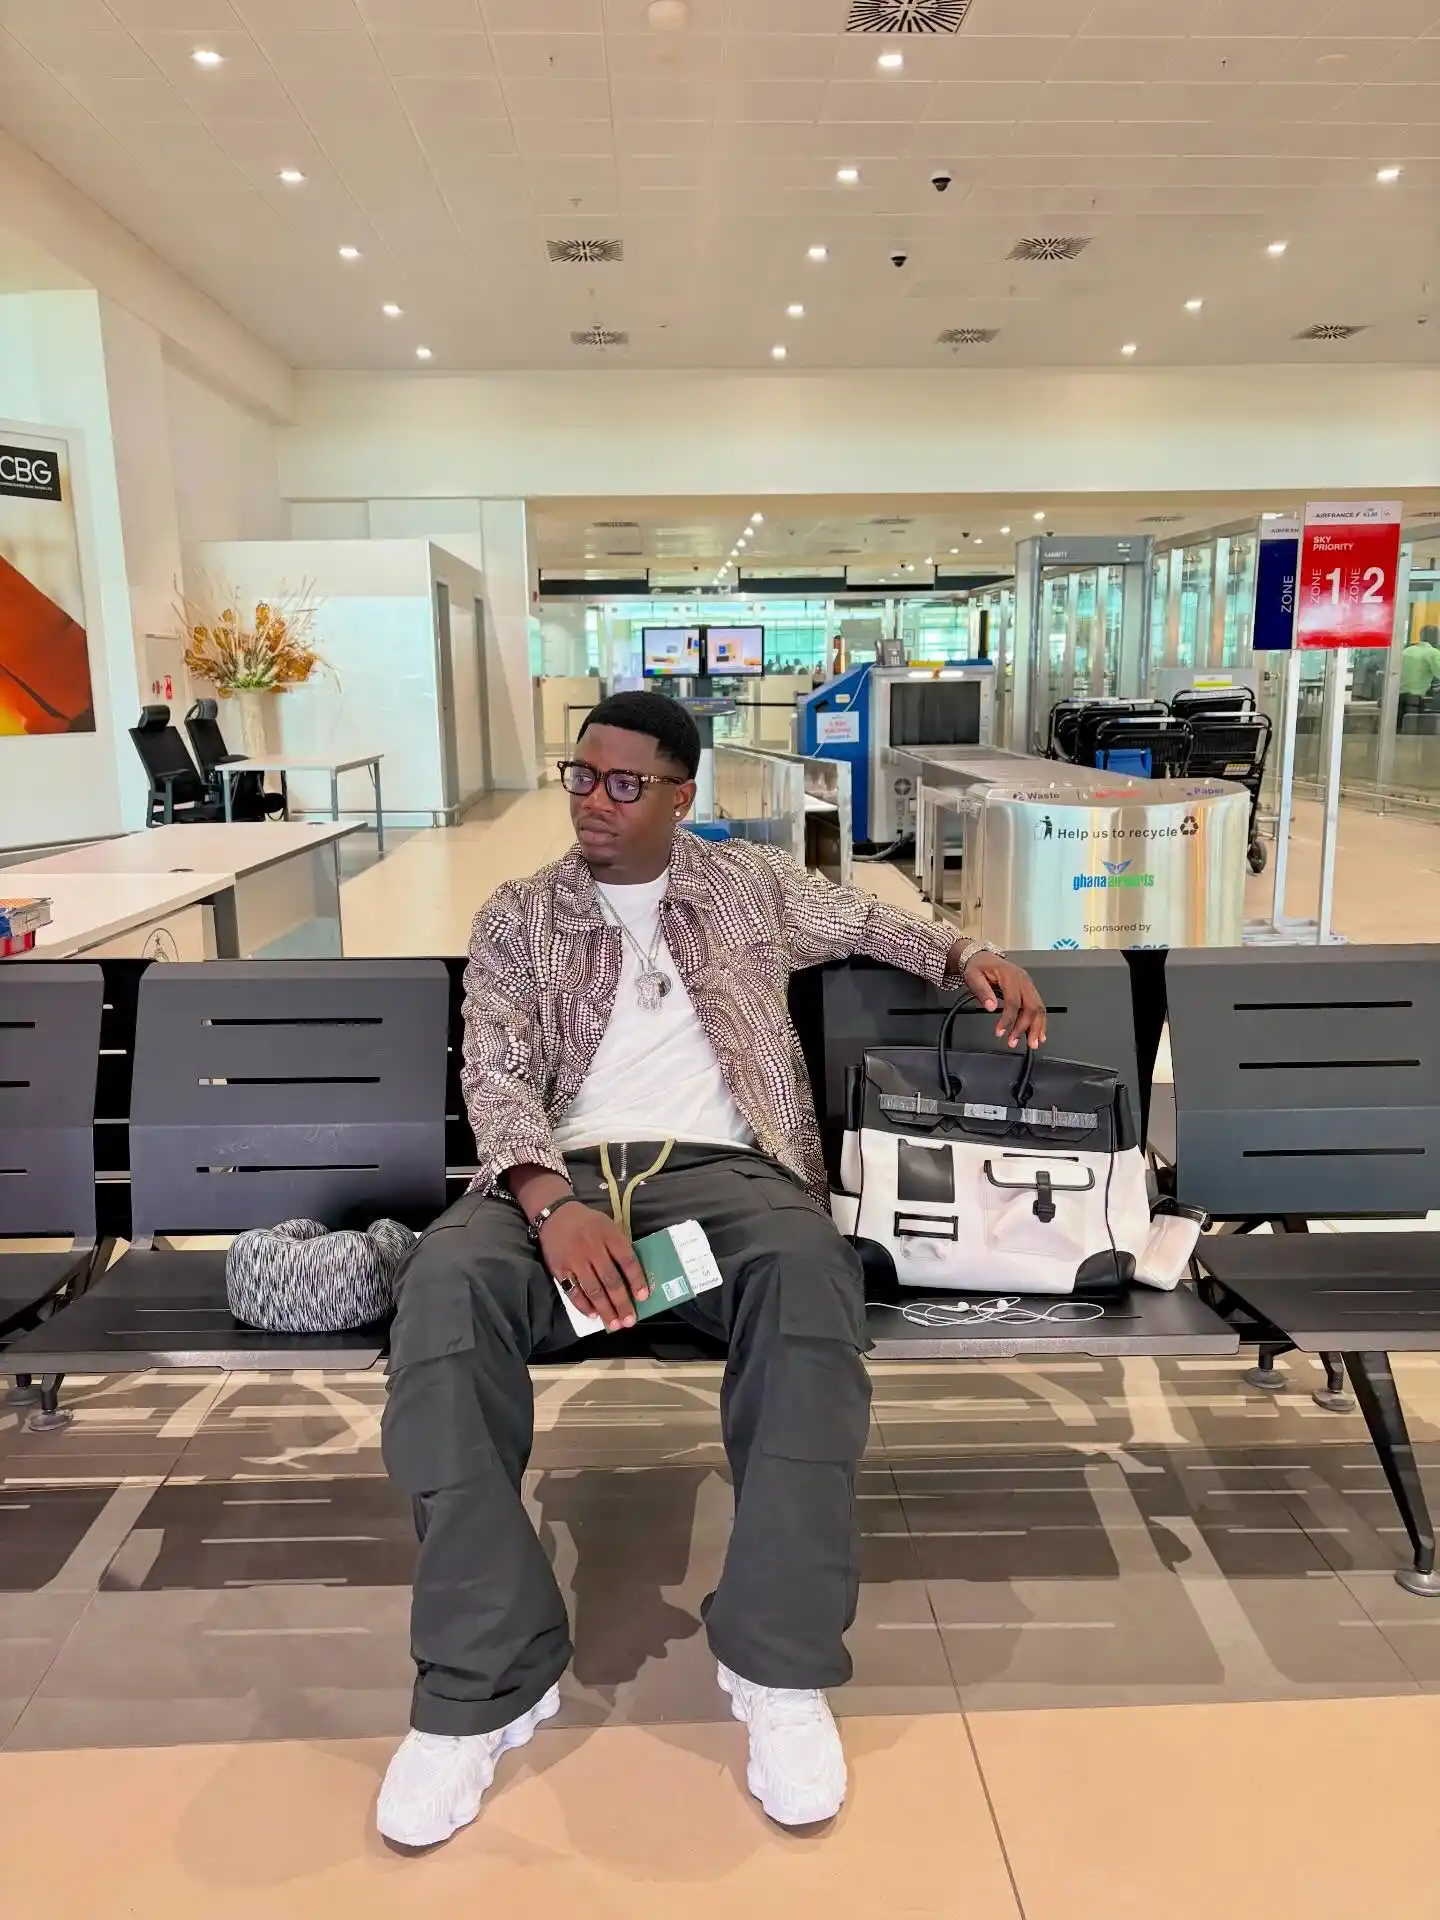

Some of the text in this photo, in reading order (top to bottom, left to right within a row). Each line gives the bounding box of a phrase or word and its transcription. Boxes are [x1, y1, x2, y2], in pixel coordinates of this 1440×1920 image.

[0, 456, 52, 484] CBG
[1281, 575, 1294, 613] ZONE
[1311, 567, 1341, 605] ZONE 1
[1350, 566, 1385, 604] ZONE 2
[1027, 791, 1060, 800] Waste
[1057, 827, 1178, 840] Help us to recycle
[1083, 922, 1152, 934] Sponsored by
